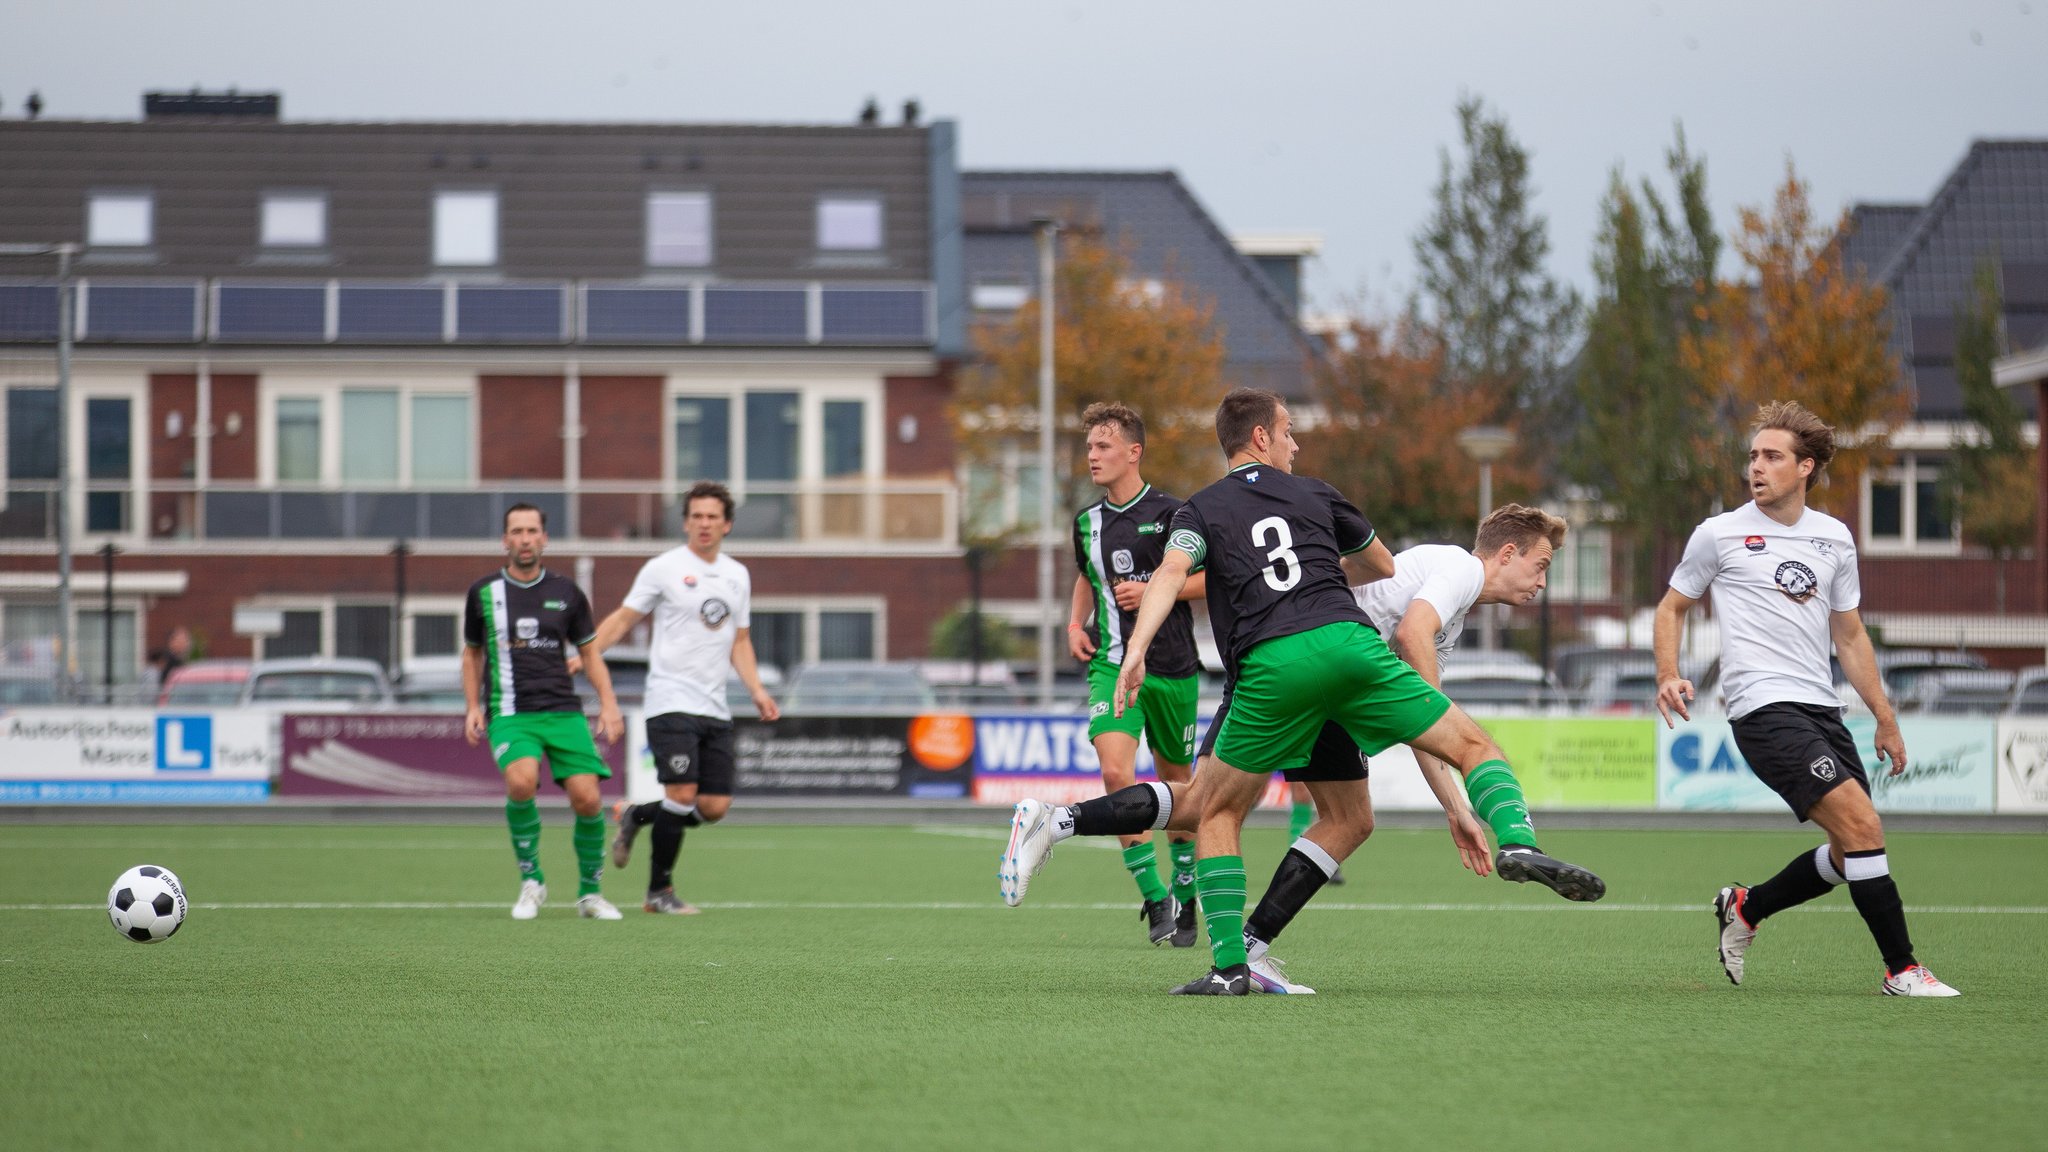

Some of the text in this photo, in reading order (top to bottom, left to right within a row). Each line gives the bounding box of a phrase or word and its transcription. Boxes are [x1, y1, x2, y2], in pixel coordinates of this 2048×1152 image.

[1251, 516, 1301, 592] 3
[980, 721, 1157, 773] WATS
[1183, 723, 1194, 742] 10
